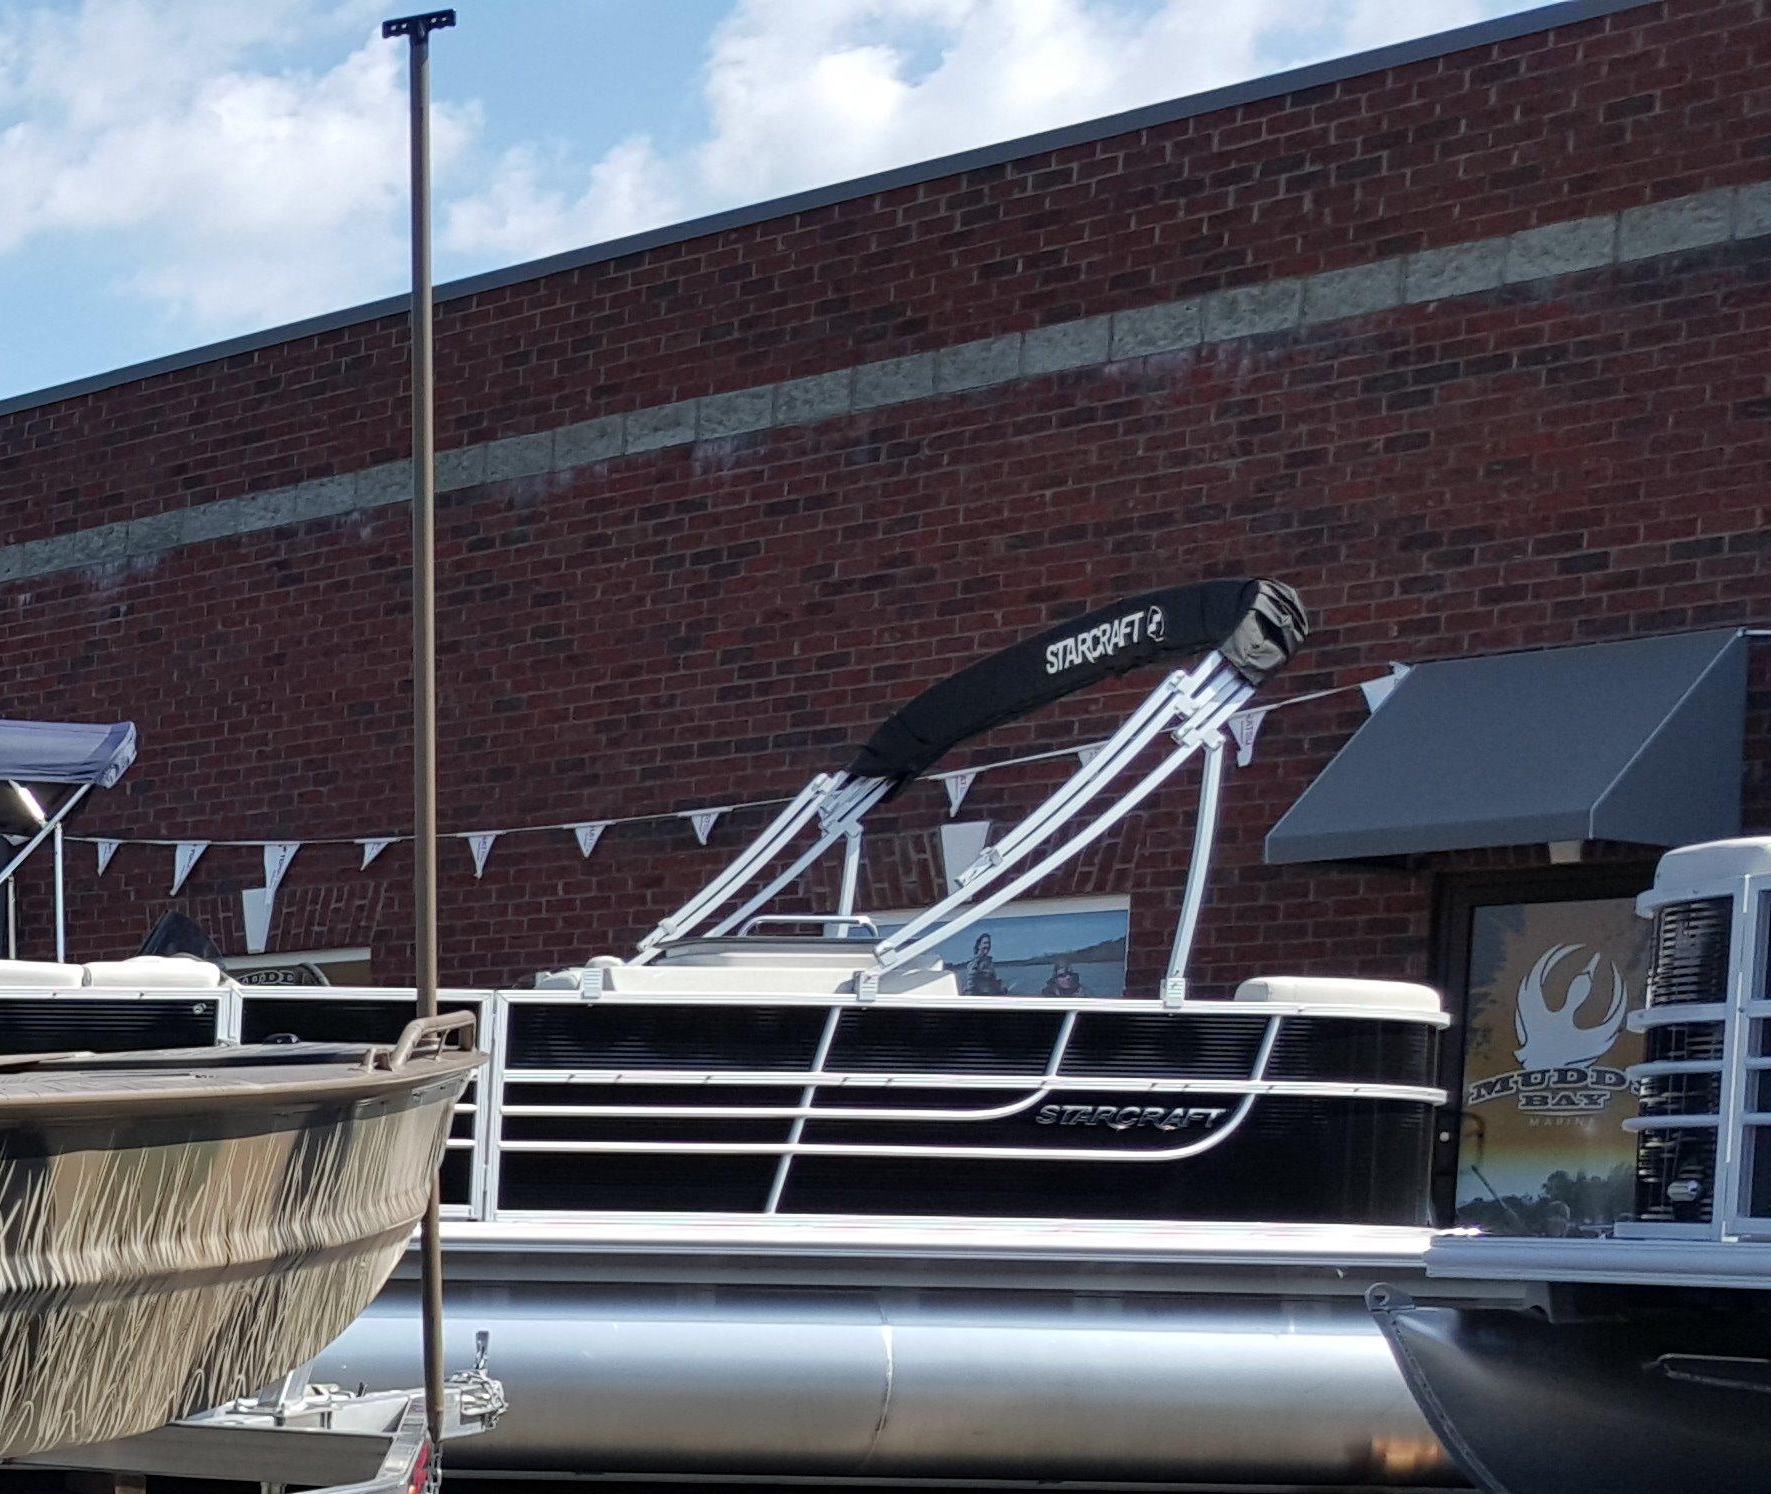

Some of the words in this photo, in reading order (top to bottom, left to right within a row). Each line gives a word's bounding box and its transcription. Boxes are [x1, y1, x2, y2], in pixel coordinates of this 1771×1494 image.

[1045, 611, 1145, 675] STARCRAFT
[1469, 1066, 1641, 1106] MUDD
[1518, 1090, 1611, 1111] BAY
[1036, 1104, 1227, 1131] STARCRAFT
